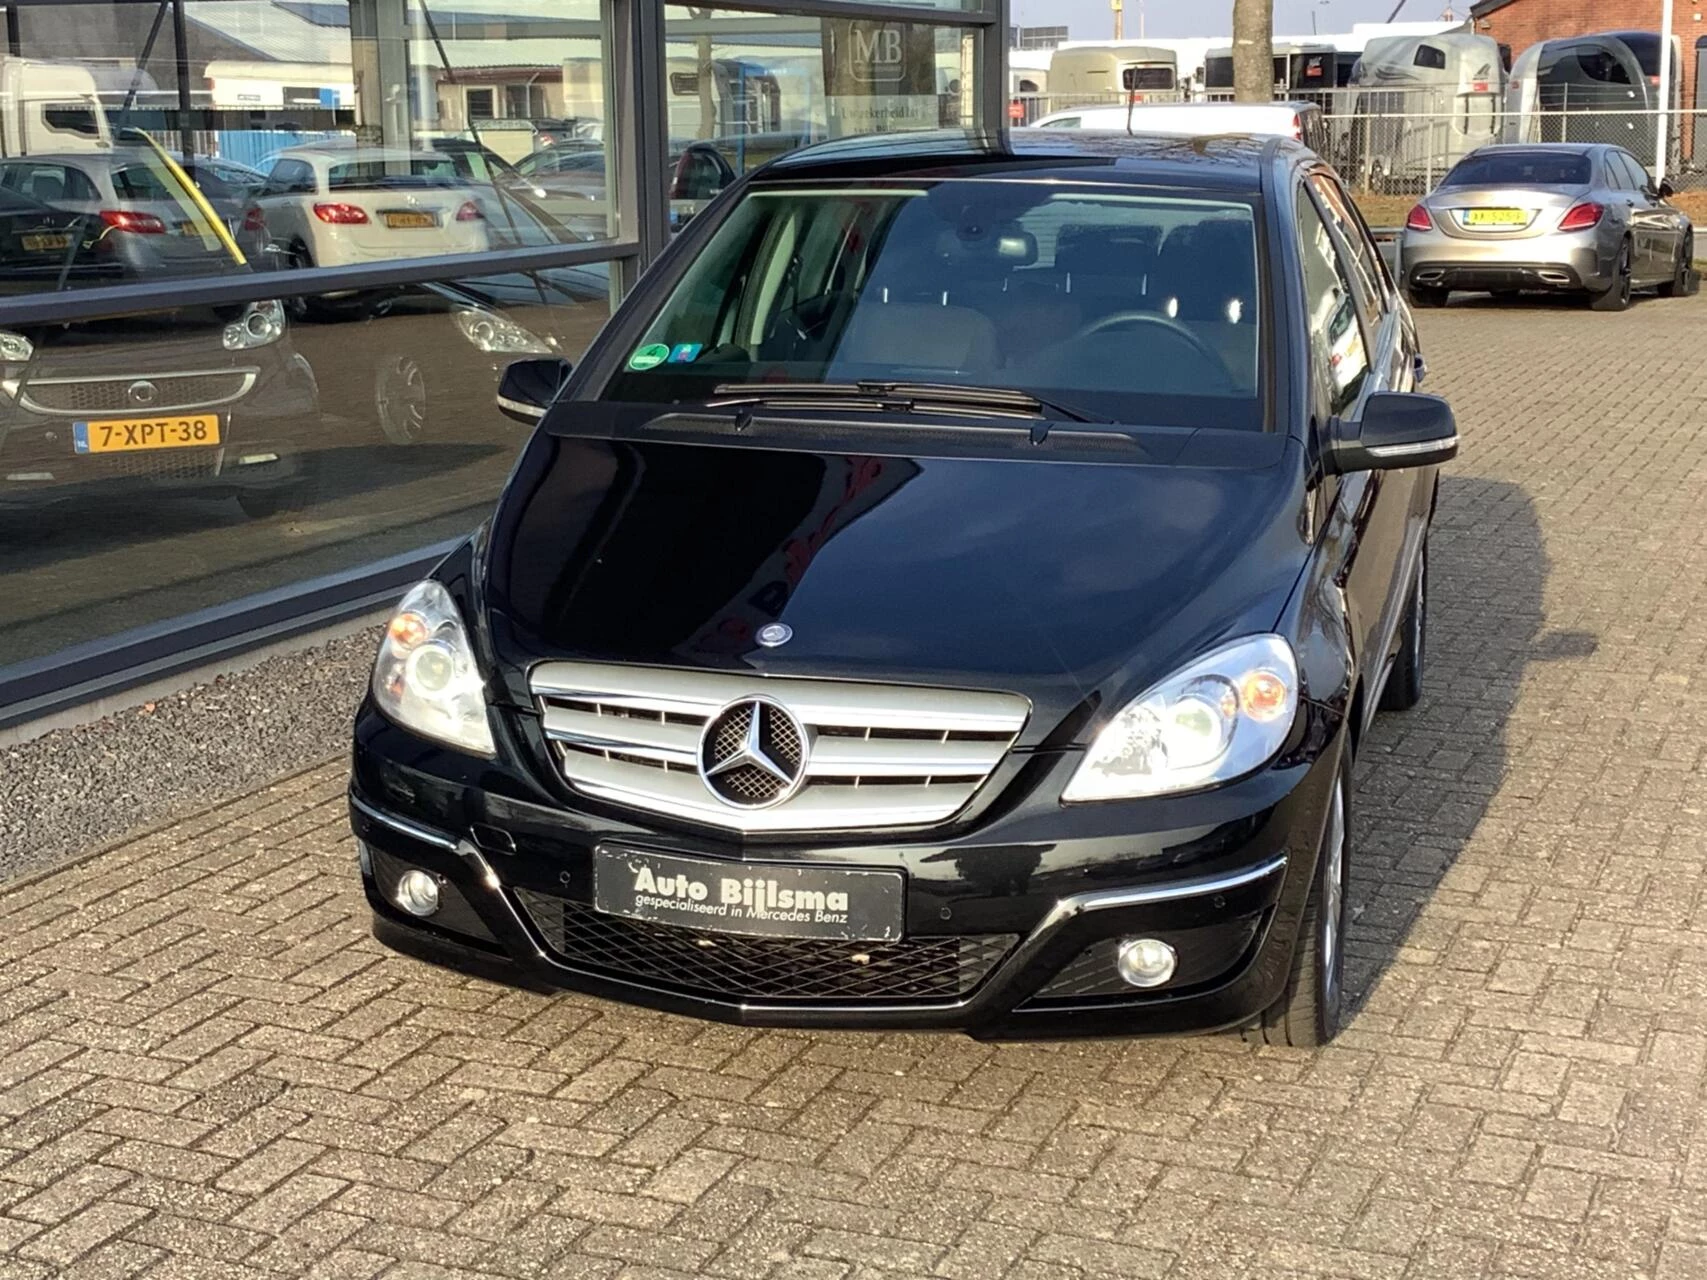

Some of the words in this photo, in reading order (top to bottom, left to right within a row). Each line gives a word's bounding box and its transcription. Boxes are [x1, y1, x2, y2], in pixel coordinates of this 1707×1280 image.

[853, 29, 902, 64] MB
[100, 420, 208, 447] 7-XPT-38
[634, 866, 708, 901] Auto
[721, 877, 848, 914] Bijlsma
[635, 895, 728, 916] gespecialiseerd
[730, 905, 743, 918] in
[746, 907, 811, 922] Mercedes
[814, 910, 848, 924] Benz
